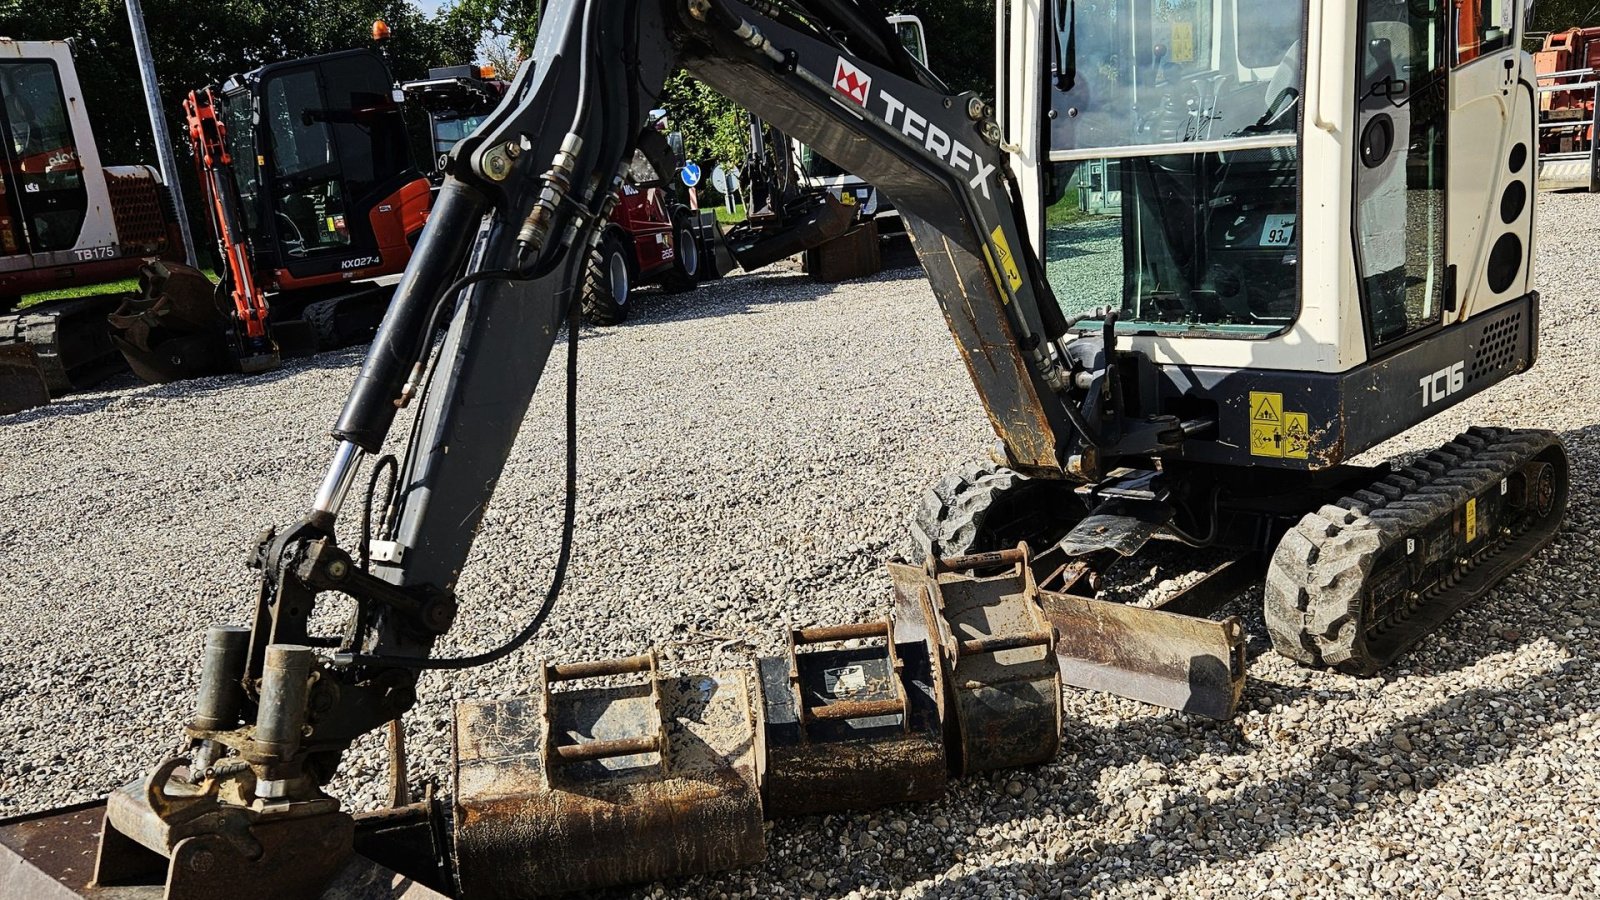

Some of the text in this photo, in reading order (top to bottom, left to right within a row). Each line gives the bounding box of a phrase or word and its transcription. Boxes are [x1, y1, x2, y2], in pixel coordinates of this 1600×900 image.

[879, 89, 996, 200] TEREX
[1268, 229, 1284, 243] 93
[75, 246, 115, 261] TB175
[341, 256, 380, 269] KX027-4
[1419, 359, 1465, 408] TC16
